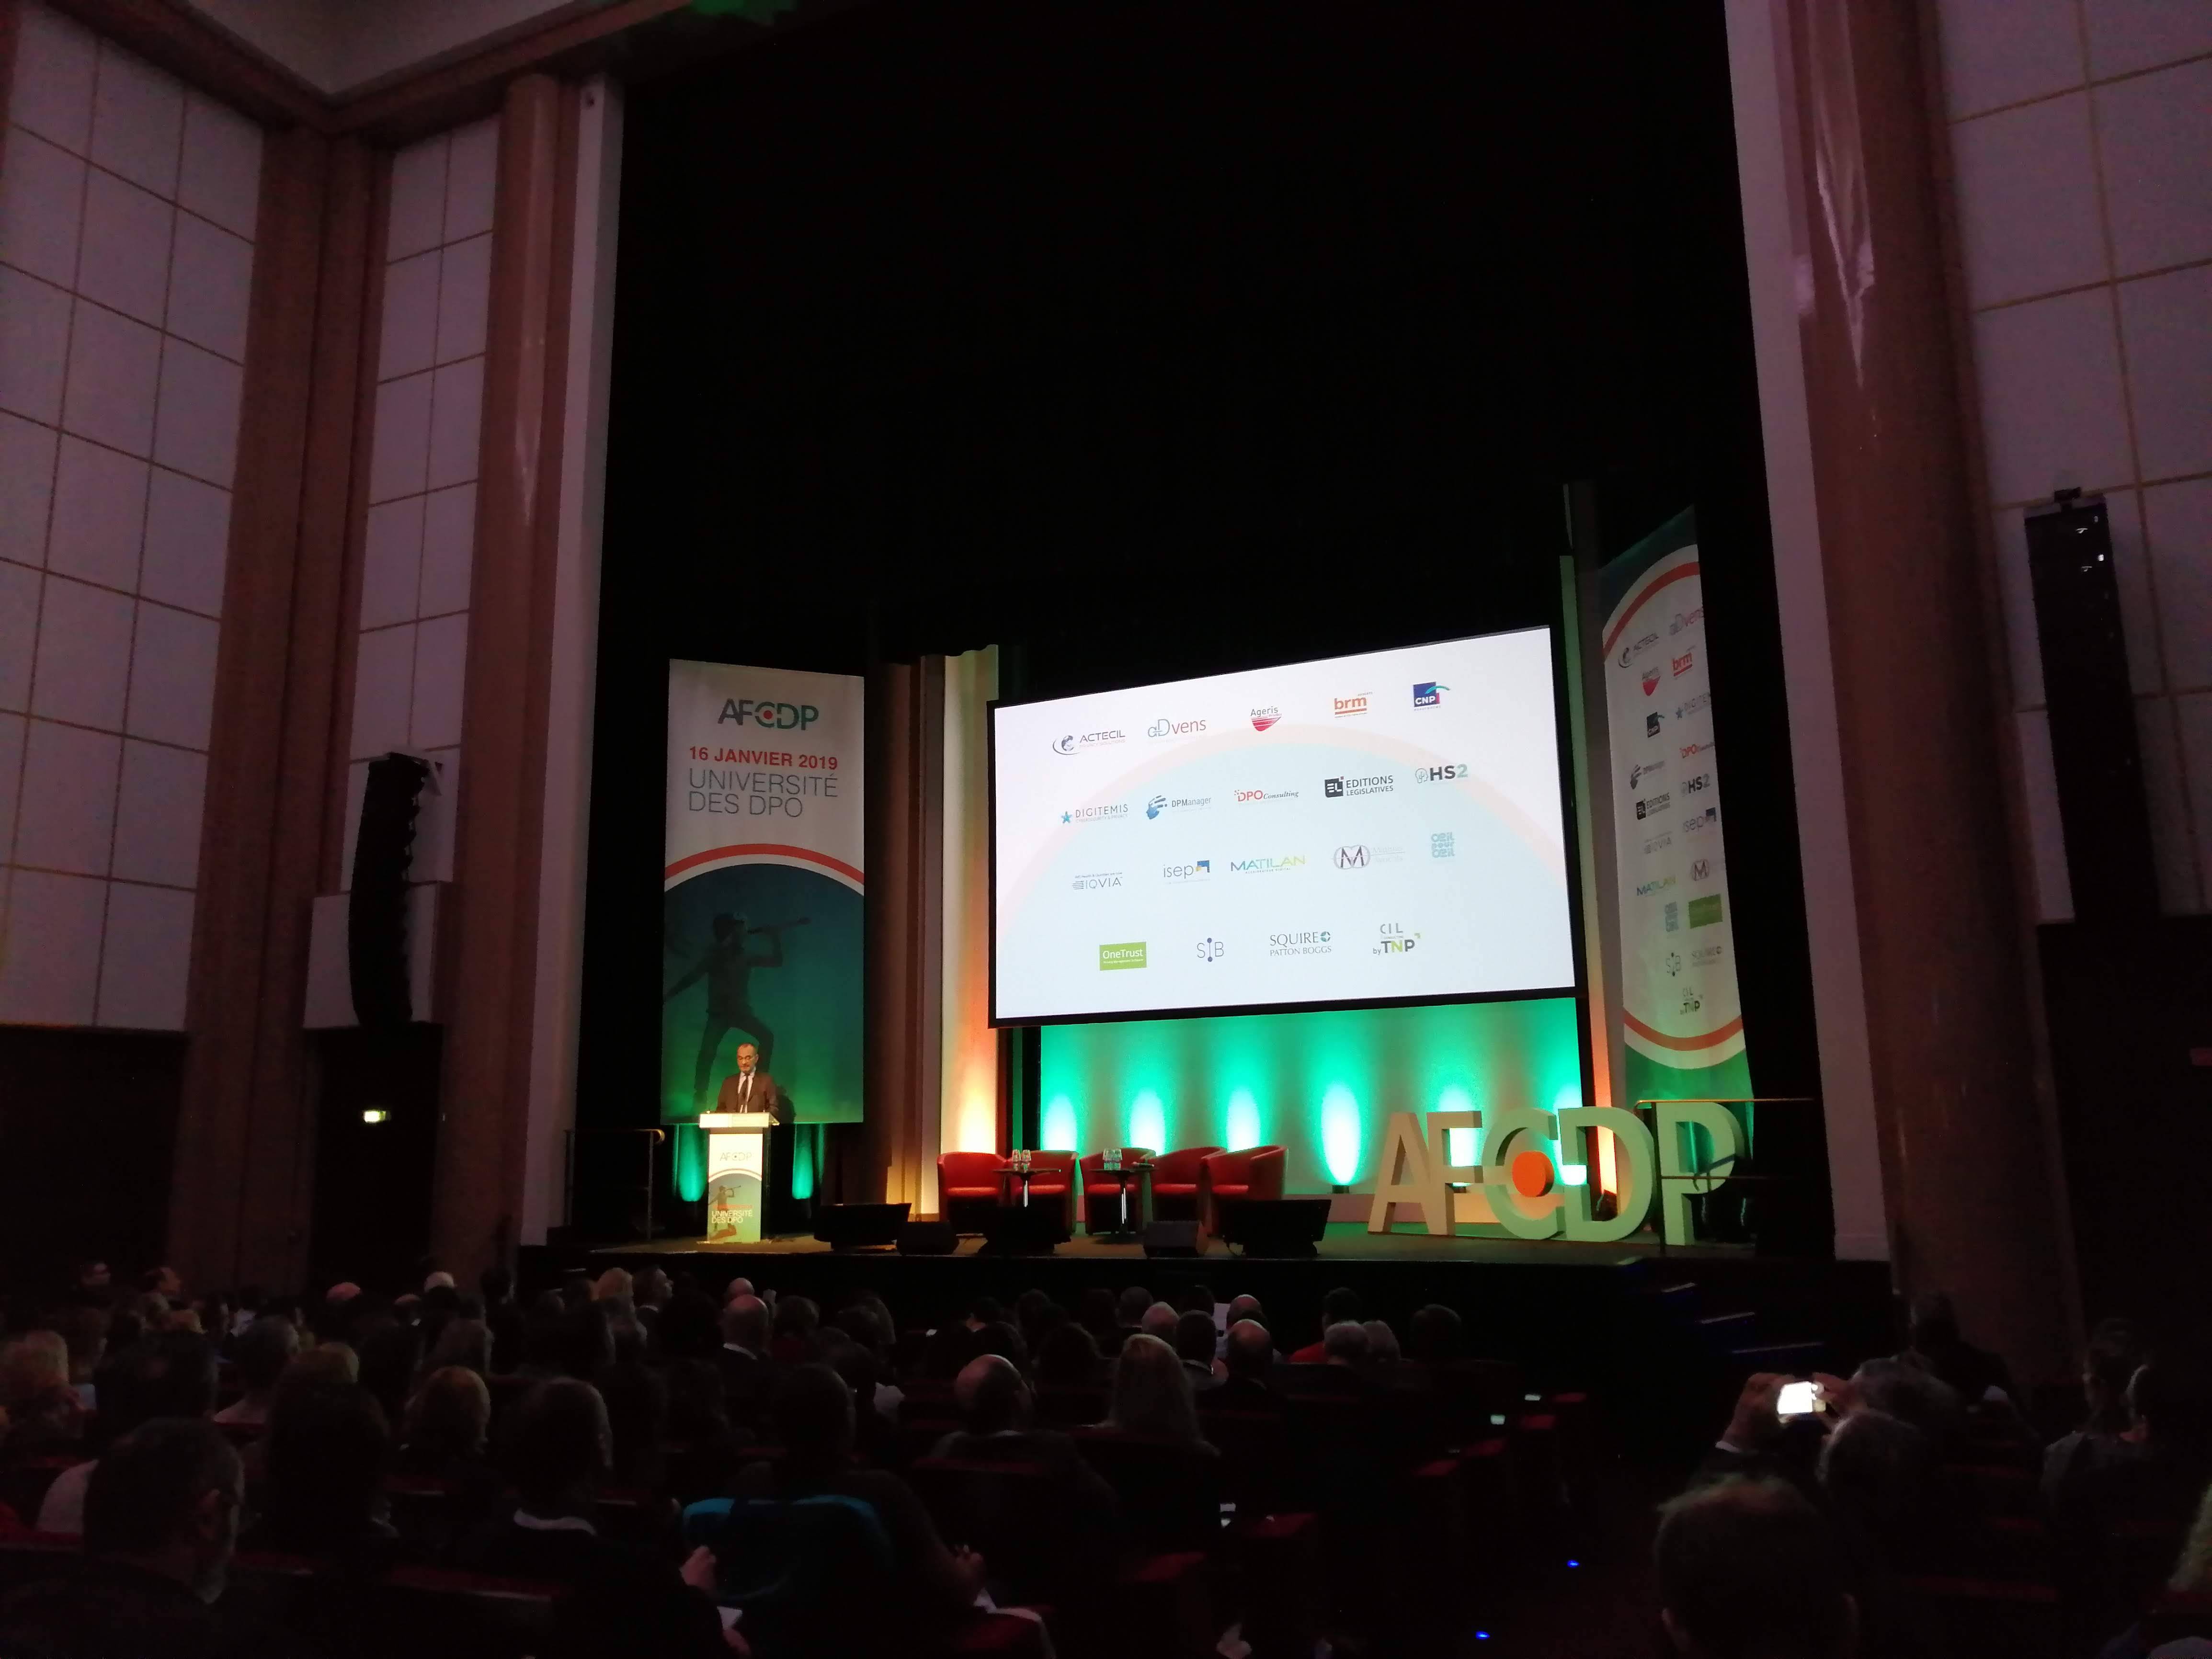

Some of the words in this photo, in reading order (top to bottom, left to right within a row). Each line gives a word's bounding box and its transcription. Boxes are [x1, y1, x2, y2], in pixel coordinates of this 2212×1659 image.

[1673, 652, 1692, 671] brm
[1334, 697, 1367, 710] brm
[1415, 695, 1436, 705] CNP
[718, 698, 819, 730] AFCDP
[1250, 705, 1278, 717] Ageris
[1080, 729, 1126, 743] ACTECIL
[689, 746, 709, 761] 16
[714, 748, 792, 767] JANVIER
[798, 754, 838, 770] 2019
[1429, 763, 1468, 781] HS2
[689, 767, 839, 797] UNIVERSITÉ
[1346, 775, 1393, 788] EDITIONS
[1688, 773, 1710, 794] HS2
[1237, 790, 1264, 802] DPO
[1263, 790, 1299, 800] Consulting
[1346, 785, 1394, 796] LEGISLATIVES
[689, 791, 739, 814] DES
[749, 795, 803, 818] DPO
[1172, 797, 1211, 807] DPManager
[1075, 804, 1129, 818] DIGITEMIS
[1231, 854, 1306, 872] MATILAN
[1163, 864, 1194, 879] isep
[1085, 877, 1122, 889] IQVIA
[1380, 923, 1403, 934] CIL
[1270, 932, 1319, 948] SQUIRE
[1372, 947, 1381, 955] by
[1380, 939, 1415, 953] TNP
[1102, 949, 1143, 959] OneTrust
[1270, 948, 1300, 956] PATTON
[1302, 945, 1332, 954] BOGGS
[719, 1152, 752, 1161] AFCDP
[1368, 1102, 1746, 1246] AFCDP
